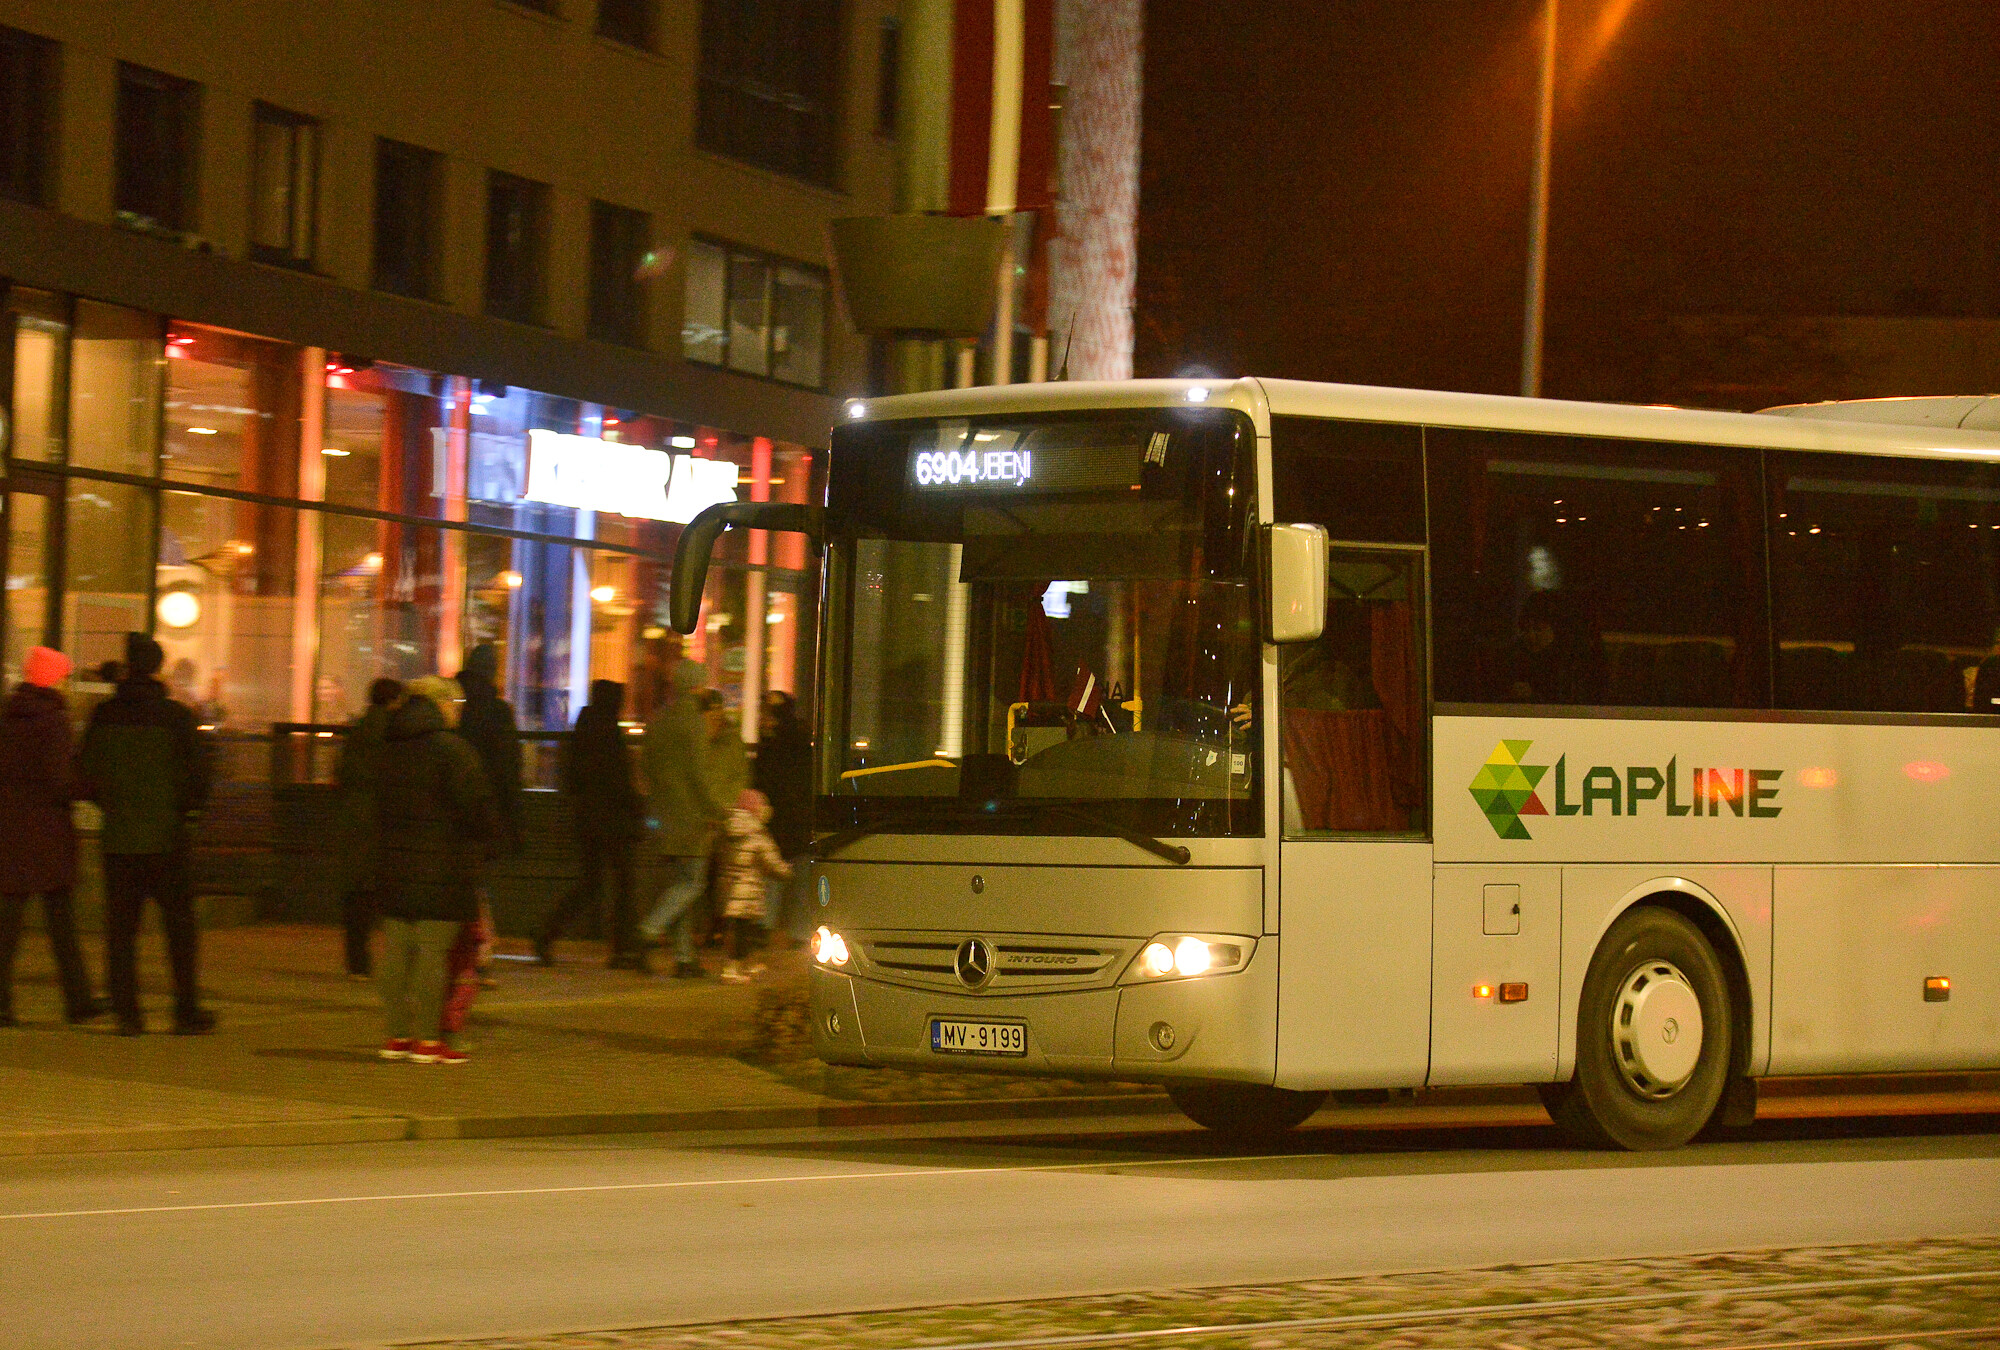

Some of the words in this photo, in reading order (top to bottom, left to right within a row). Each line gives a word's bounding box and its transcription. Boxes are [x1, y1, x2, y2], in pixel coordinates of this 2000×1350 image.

[916, 450, 979, 485] 6904
[1555, 752, 1784, 818] LAPLINE
[1008, 955, 1079, 965] INTOURO
[944, 1024, 1021, 1049] MV-9199
